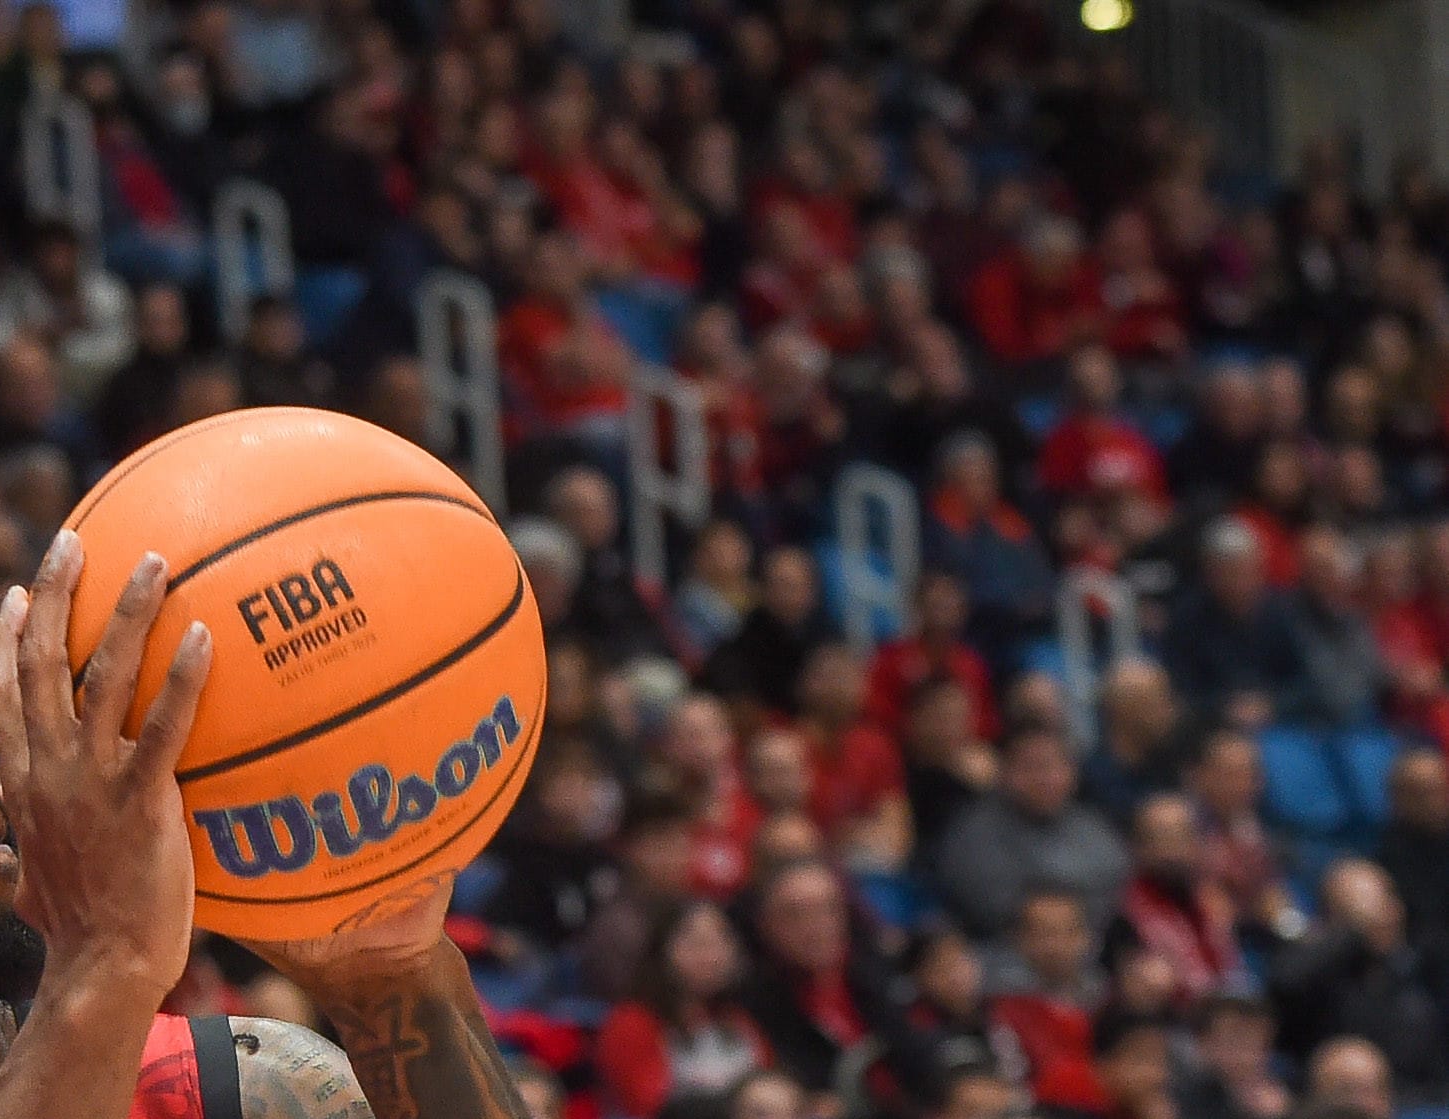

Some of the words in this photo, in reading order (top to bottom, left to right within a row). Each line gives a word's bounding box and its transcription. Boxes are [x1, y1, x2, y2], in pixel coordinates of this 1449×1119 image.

[237, 559, 354, 644] FIBA
[264, 606, 367, 670] APPROVED
[193, 695, 523, 878] Wilson
